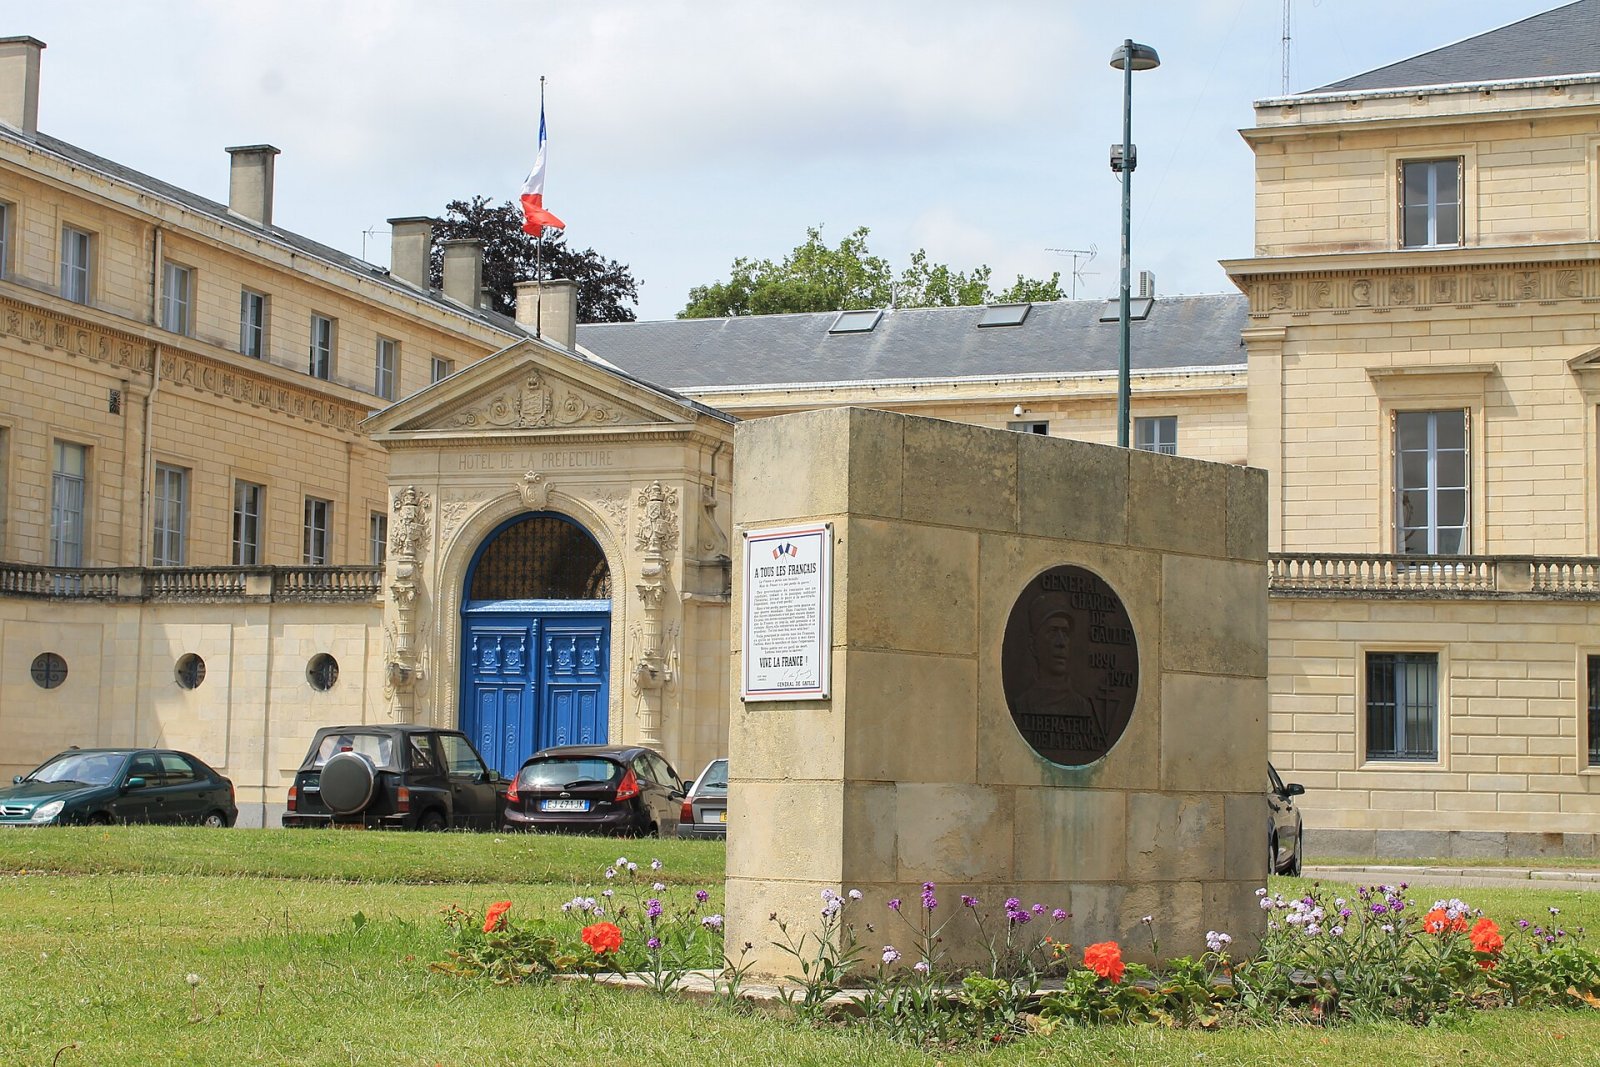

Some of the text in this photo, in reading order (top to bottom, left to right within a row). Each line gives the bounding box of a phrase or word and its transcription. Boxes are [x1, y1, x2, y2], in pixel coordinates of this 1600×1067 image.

[459, 451, 613, 470] HOTEL DE LA PREFECTURE
[754, 562, 817, 578] A TOUS LES FRANÇAIS
[1042, 575, 1100, 593] GENERAL
[1071, 593, 1116, 612] CHARLES
[1091, 611, 1106, 626] DE
[1090, 626, 1131, 644] GAULLE
[759, 657, 772, 668] VIVE
[773, 656, 781, 667] LA
[781, 655, 804, 667] FRANCE
[1090, 651, 1117, 668] 1890
[1108, 670, 1134, 688] 1970
[1023, 715, 1096, 734] LIBERATEUR
[1034, 732, 1048, 746] DE
[1064, 733, 1103, 750] FRANCE
